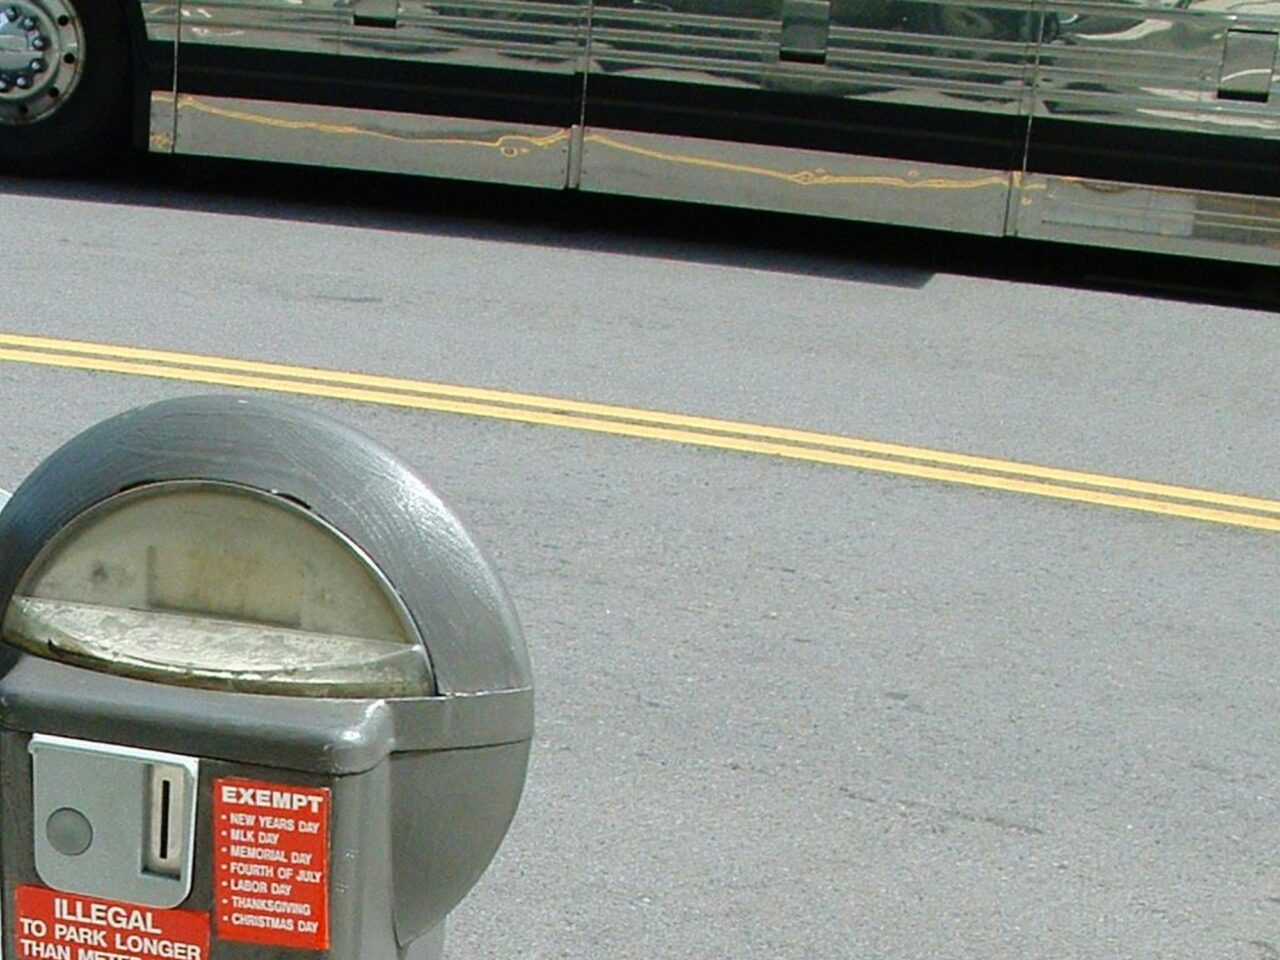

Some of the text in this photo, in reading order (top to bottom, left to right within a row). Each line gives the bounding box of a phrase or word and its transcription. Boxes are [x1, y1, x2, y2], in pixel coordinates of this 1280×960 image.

[221, 786, 323, 813] EXEMPT
[230, 813, 320, 834] NEW YEARS DAY
[230, 829, 280, 845] MLK DAY
[230, 845, 312, 865] MEMORIAL DAY
[230, 862, 321, 883] FOURTH OF JULY
[230, 879, 292, 896] LABOR DAY
[54, 897, 162, 934] ILLEGAL
[231, 896, 311, 916] THANKSGIVING
[20, 918, 47, 937] TO
[55, 924, 108, 947] PARK
[231, 913, 319, 933] CHRISTMAS DAY
